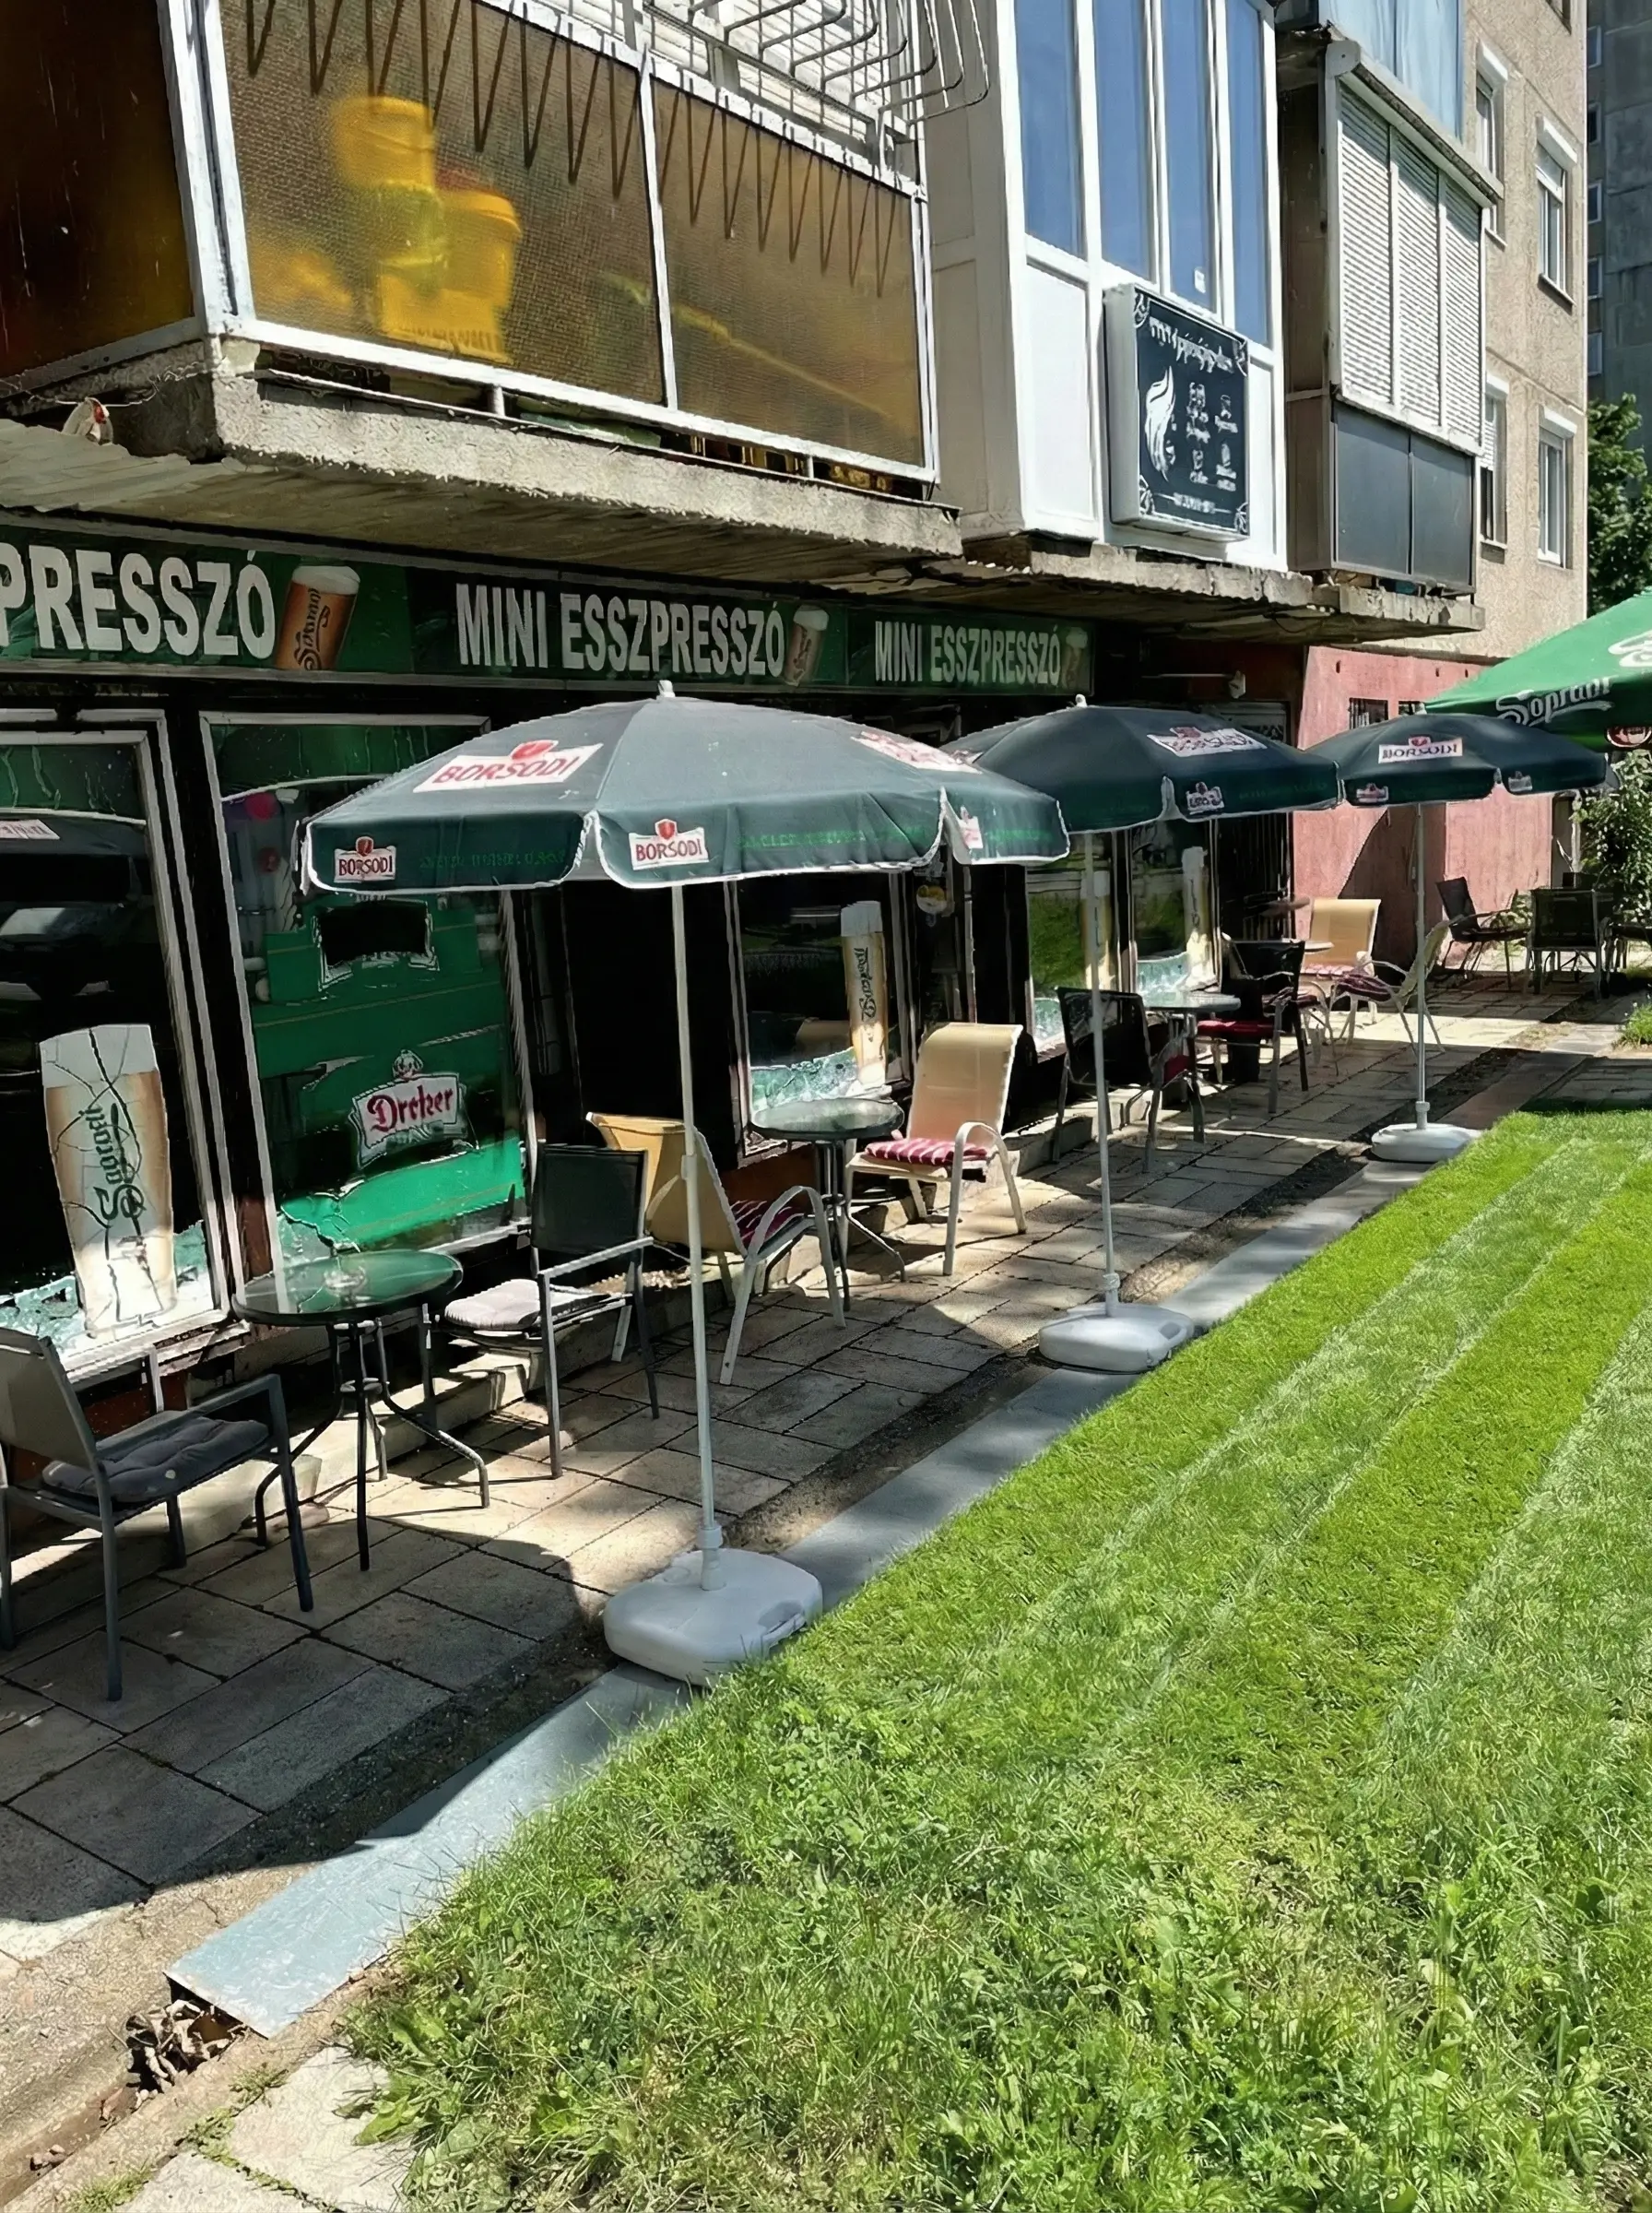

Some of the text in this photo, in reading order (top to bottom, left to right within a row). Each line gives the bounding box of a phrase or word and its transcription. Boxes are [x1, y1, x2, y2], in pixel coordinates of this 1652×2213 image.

[0, 542, 275, 659] PRESSZÓ
[455, 582, 549, 669] MINI
[560, 592, 785, 678] ESSZPRESSZÓ
[875, 620, 924, 683] MINI
[929, 624, 1061, 686] ESSZPRESSZÓ
[431, 755, 582, 784] BORSODI
[338, 855, 394, 877] BORSODI
[635, 837, 704, 862] BORSODI
